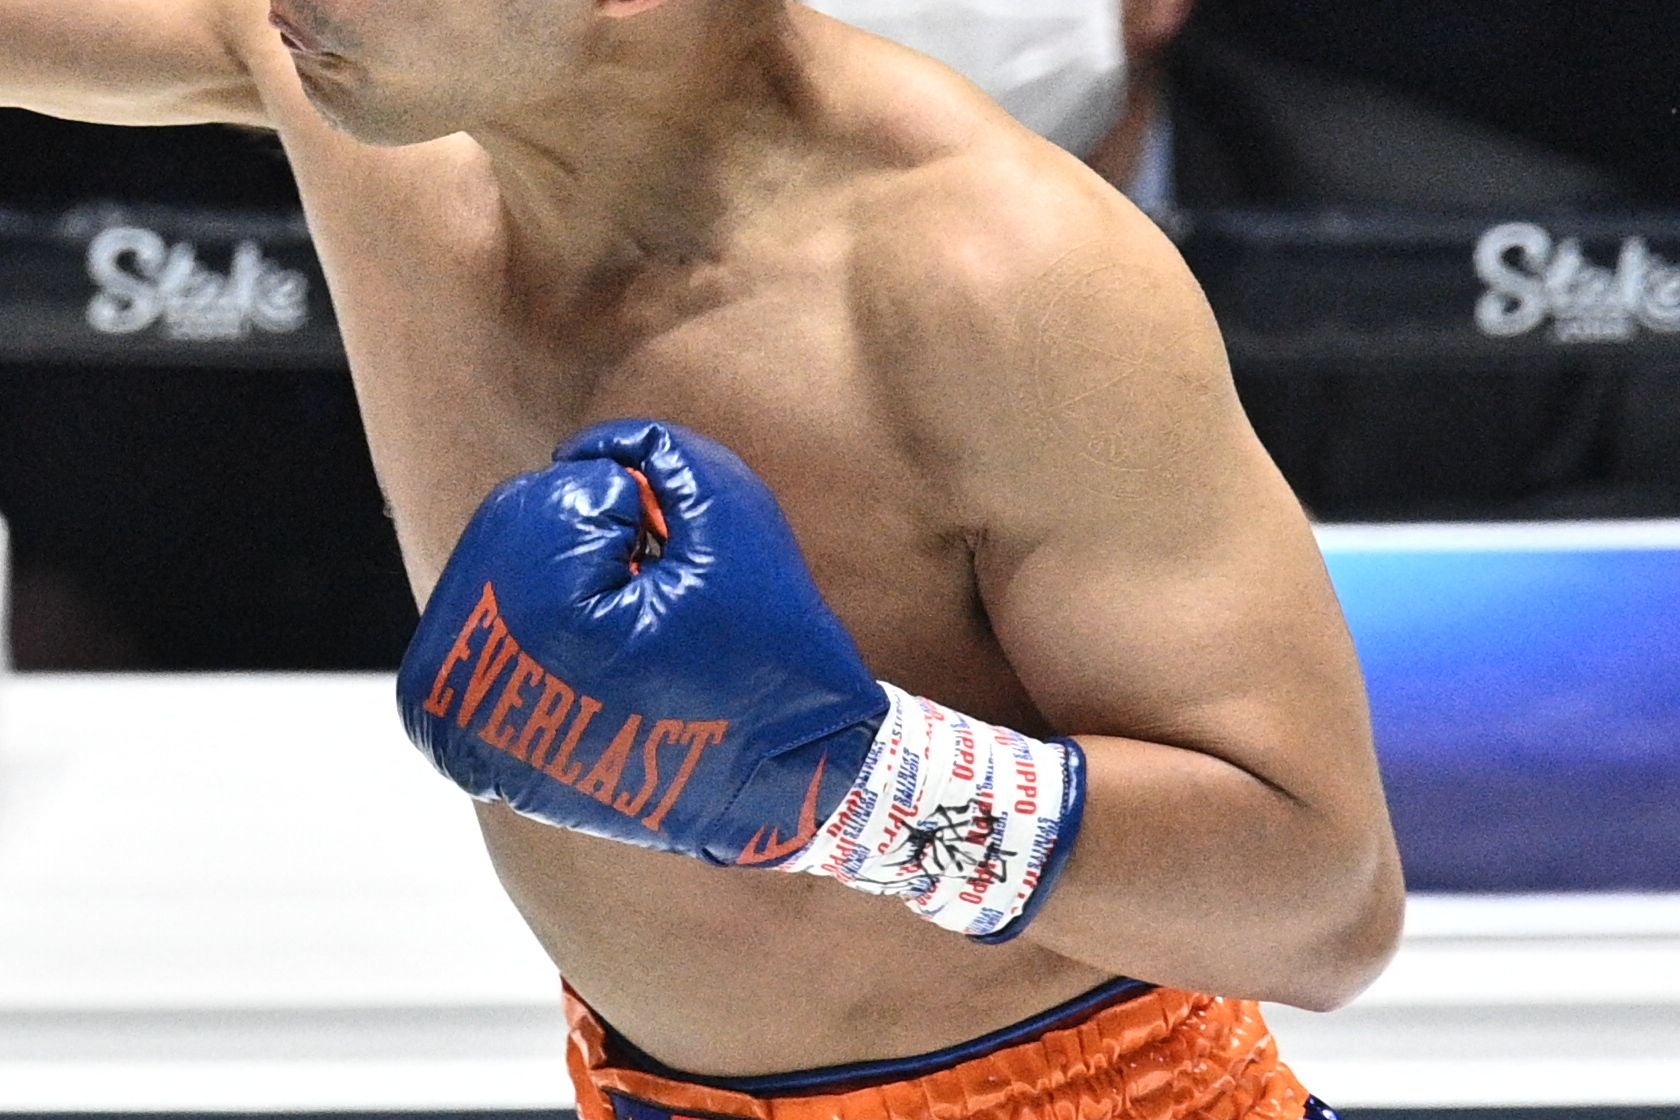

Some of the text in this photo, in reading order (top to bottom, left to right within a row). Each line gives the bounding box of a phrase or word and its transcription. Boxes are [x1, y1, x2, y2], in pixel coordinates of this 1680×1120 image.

[86, 225, 308, 334] Stake
[423, 579, 730, 832] EVERLAST
[1013, 761, 1039, 815] IPPO
